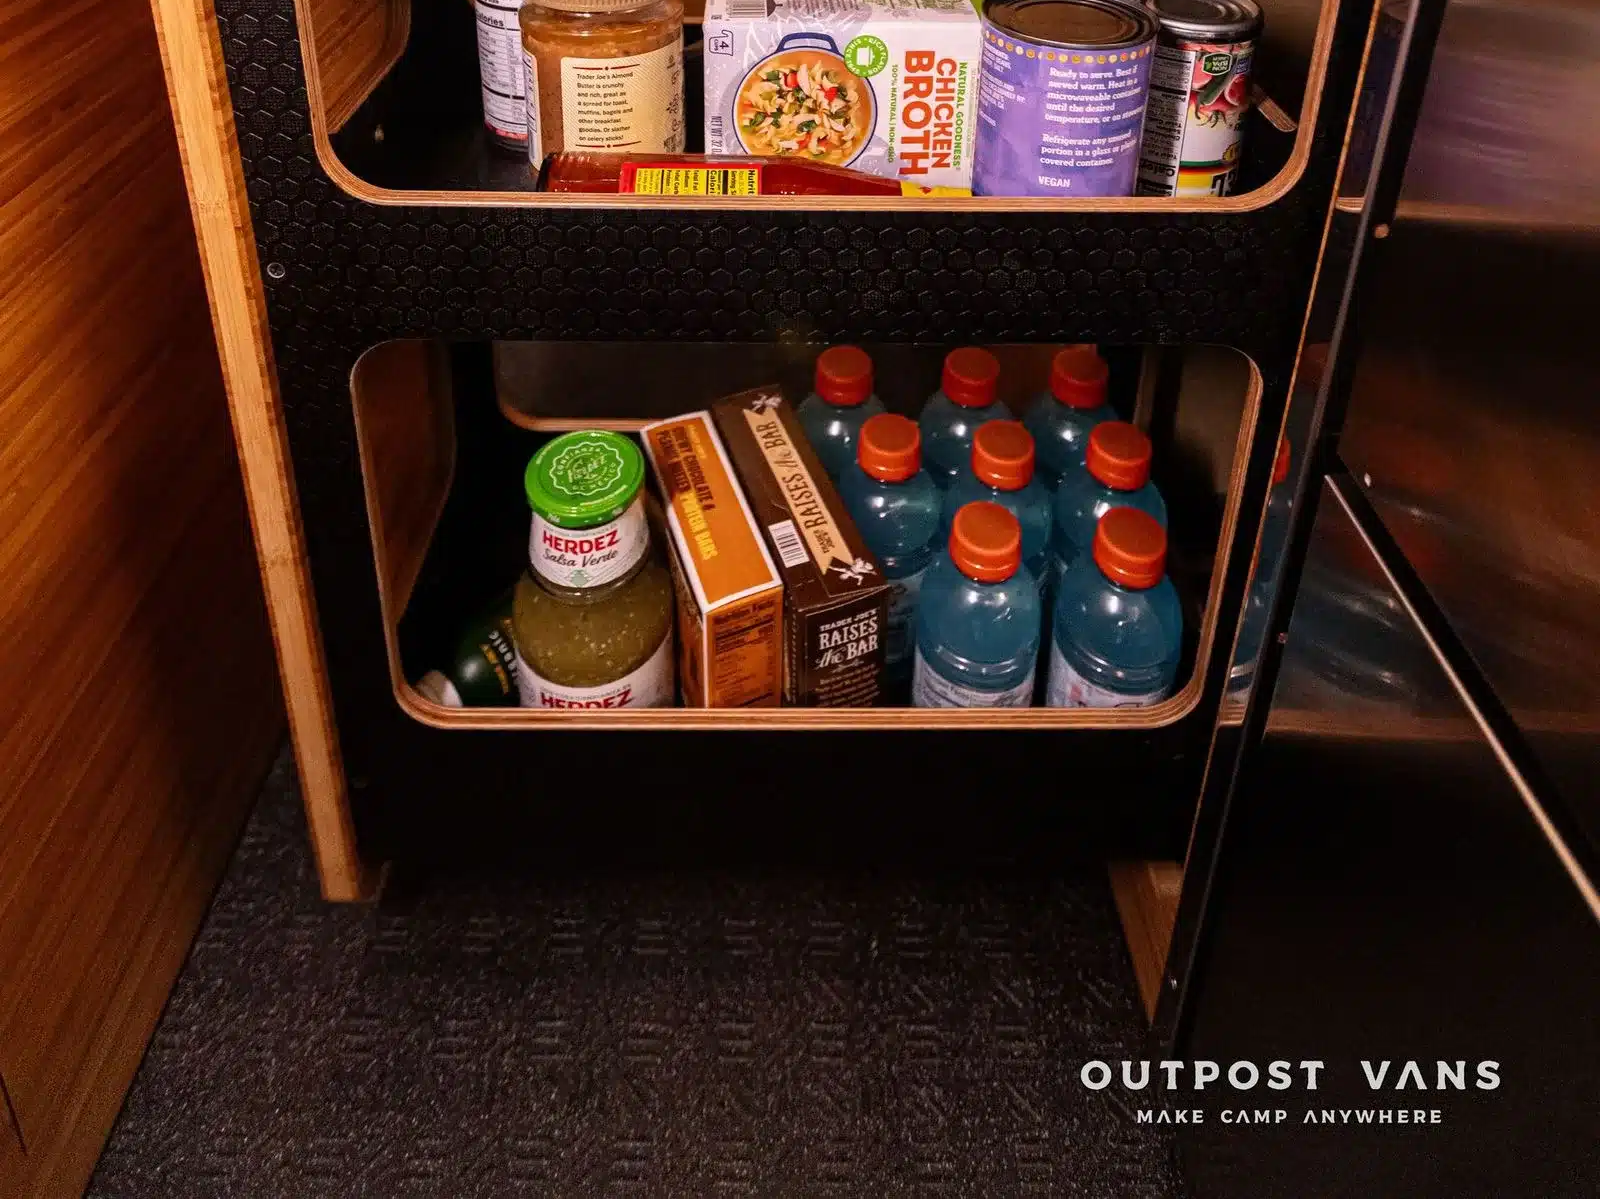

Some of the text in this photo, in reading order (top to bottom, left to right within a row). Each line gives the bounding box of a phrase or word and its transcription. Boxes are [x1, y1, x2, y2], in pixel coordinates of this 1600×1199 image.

[611, 71, 634, 79] Almond
[956, 62, 968, 109] NATURAL
[1048, 80, 1079, 90] served
[1049, 67, 1078, 80] Ready
[1079, 71, 1089, 79] to
[889, 87, 897, 122] NATURAL
[899, 50, 936, 175] BROTH
[931, 58, 957, 169] CHICKEN
[1045, 102, 1068, 112] until
[1068, 103, 1084, 112] the
[1102, 115, 1111, 123] or
[1041, 146, 1074, 156] portion
[1091, 147, 1112, 157] glass
[1042, 132, 1091, 146] Refrigerate
[1039, 156, 1075, 167] covered
[709, 169, 717, 195] Calori
[748, 169, 756, 195] Nutrit
[1038, 175, 1071, 188] VEGAN
[756, 420, 787, 450] BAR
[782, 473, 828, 529] RAISES
[542, 529, 620, 556] HERDEZ
[694, 533, 718, 561] BARS
[543, 548, 618, 568] Salsa Verde
[819, 615, 878, 650] RAISES
[814, 634, 879, 670] the BAR
